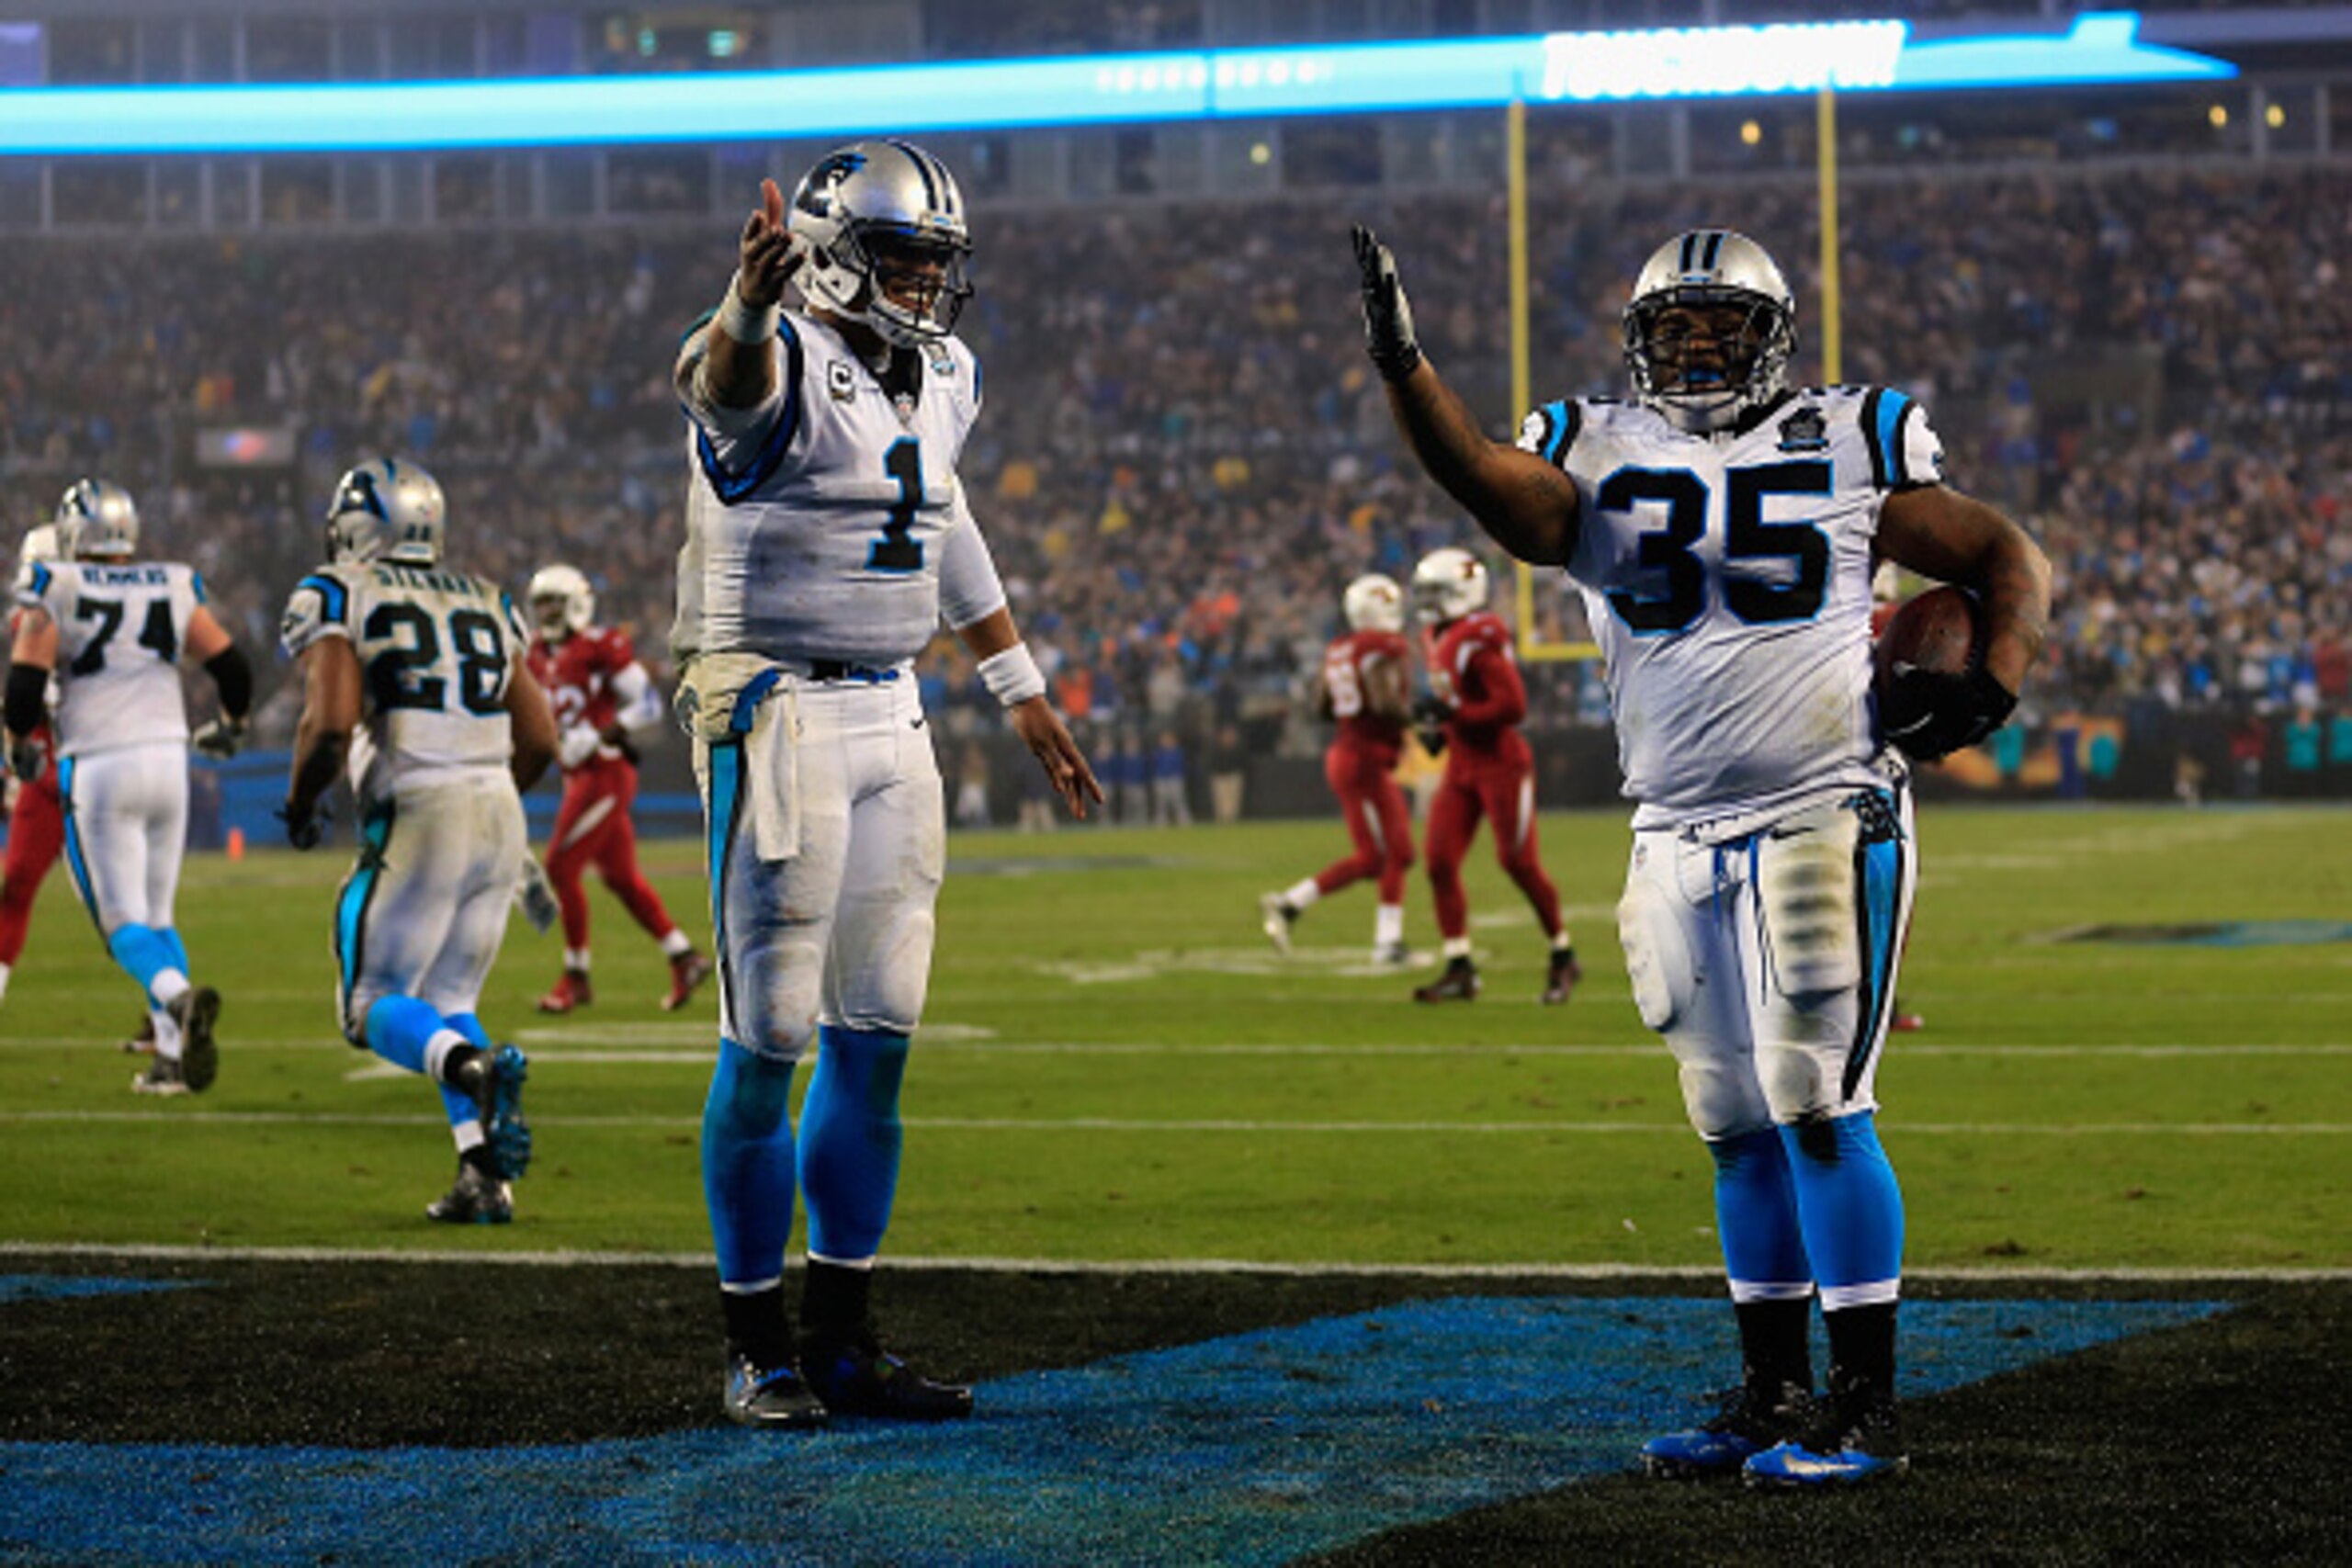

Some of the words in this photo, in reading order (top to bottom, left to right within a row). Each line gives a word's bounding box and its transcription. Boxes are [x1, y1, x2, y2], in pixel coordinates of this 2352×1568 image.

[864, 434, 925, 573] 1
[1594, 459, 1834, 637] 35
[71, 594, 178, 678] 74
[365, 601, 508, 718] 28
